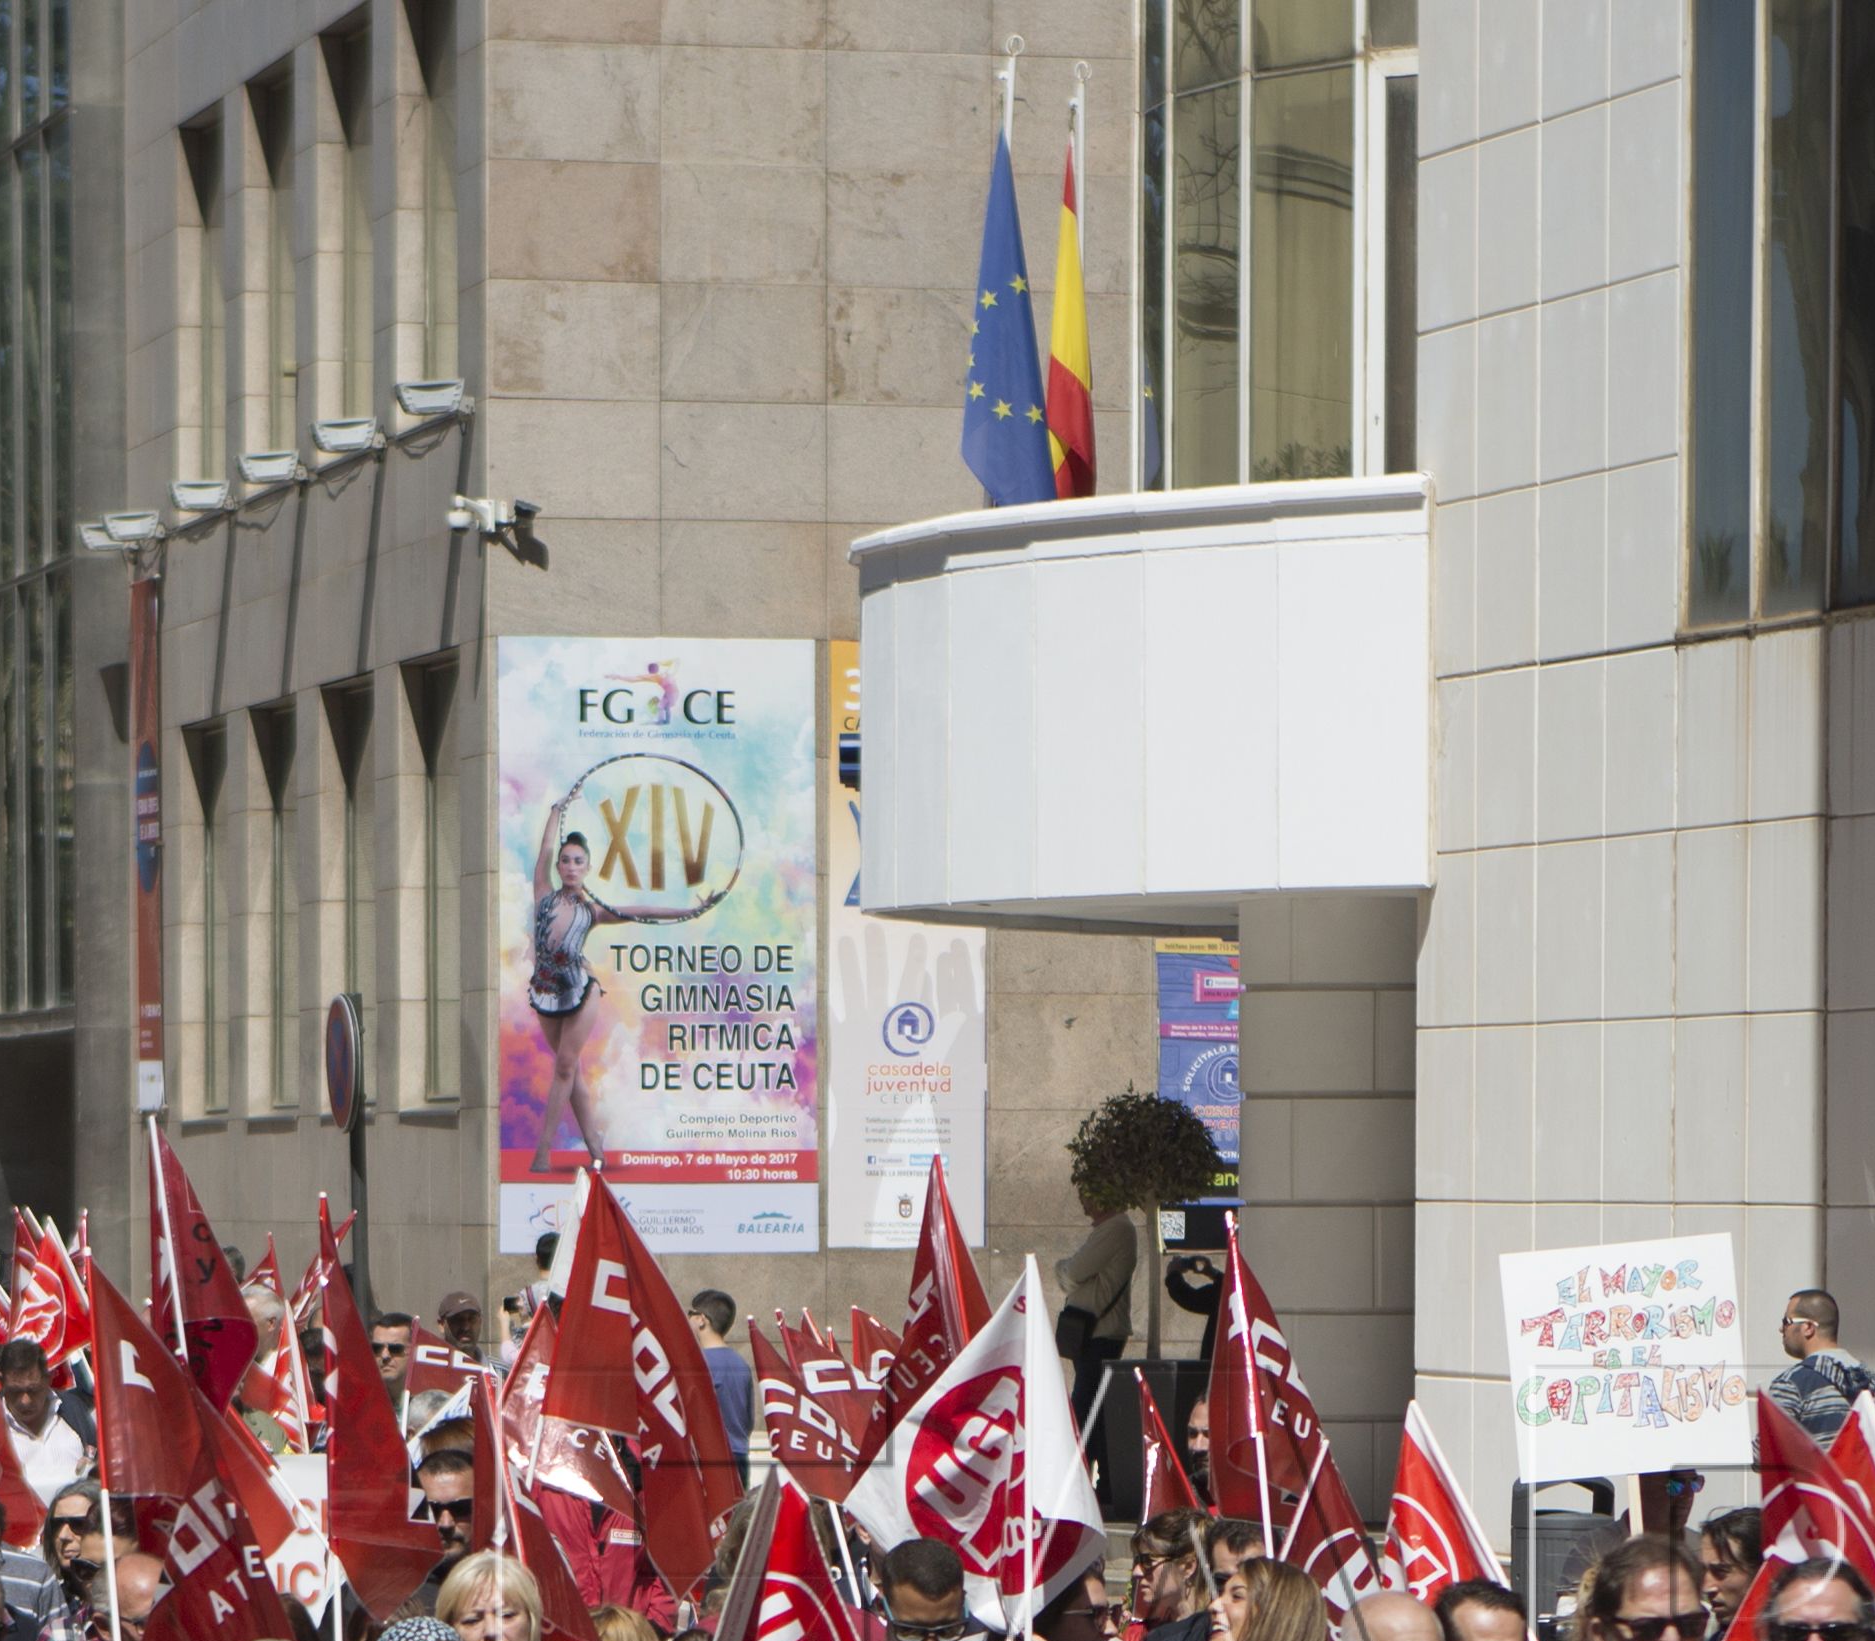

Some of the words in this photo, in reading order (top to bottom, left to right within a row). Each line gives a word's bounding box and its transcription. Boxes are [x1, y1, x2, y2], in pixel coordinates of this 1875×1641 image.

[598, 783, 715, 892] XIV
[610, 944, 743, 974] TORNEO
[753, 944, 795, 973] DE
[641, 983, 796, 1013] GIMNASIA
[668, 1023, 797, 1051] RITMICA
[640, 1062, 682, 1091] DE
[692, 1062, 797, 1091] CEUTA
[866, 1078, 952, 1096] juventud
[880, 1094, 939, 1105] CEUTA
[679, 1113, 736, 1126] Complejo
[740, 1113, 798, 1125] Deportivo
[666, 1128, 724, 1140] Guillermo
[727, 1128, 767, 1139] Molina
[622, 1153, 683, 1168] Domingo,
[686, 1154, 693, 1166] 7
[696, 1153, 712, 1166] de
[715, 1154, 747, 1168] Mayo
[750, 1153, 766, 1166] de
[769, 1153, 798, 1166] 2017
[726, 1169, 760, 1181] 10:30
[762, 1169, 798, 1181] horas
[1556, 1264, 1592, 1308] EL
[1598, 1259, 1703, 1299] MAYOR
[1592, 1347, 1622, 1370] ES
[1631, 1343, 1662, 1368] EL
[769, 1427, 857, 1473] CEUT
[913, 1376, 1021, 1518] UGT
